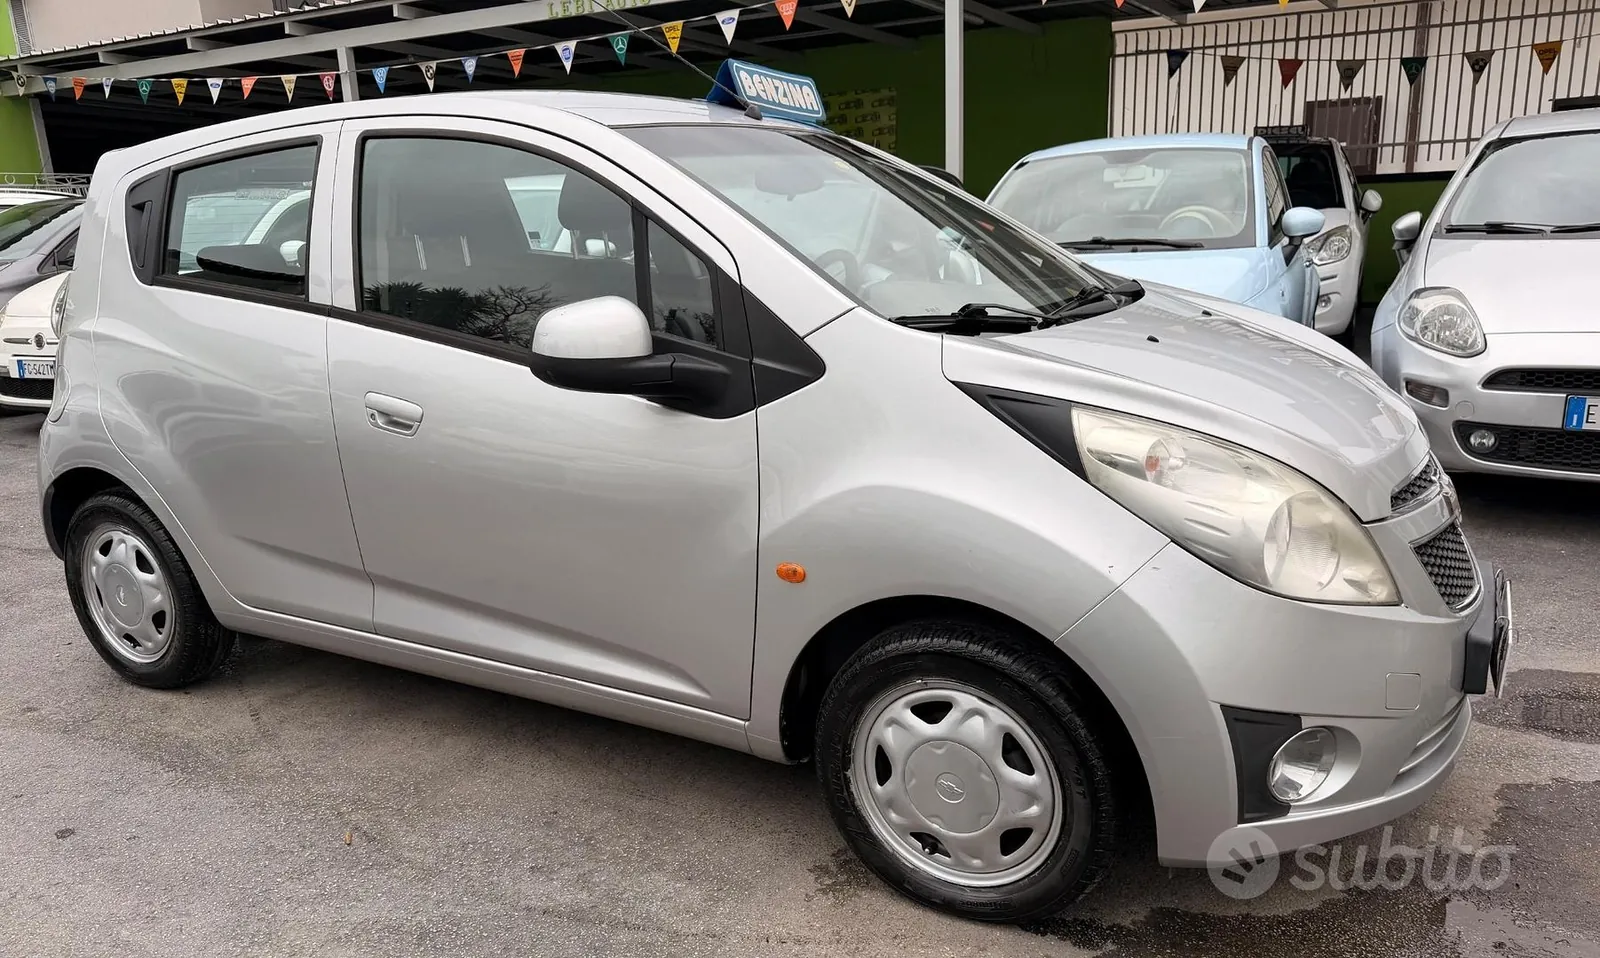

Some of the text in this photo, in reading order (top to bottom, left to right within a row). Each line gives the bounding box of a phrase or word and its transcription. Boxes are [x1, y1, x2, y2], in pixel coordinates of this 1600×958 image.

[606, 0, 650, 10] AU
[664, 25, 680, 34] OPEL
[739, 70, 819, 111] BENZINA
